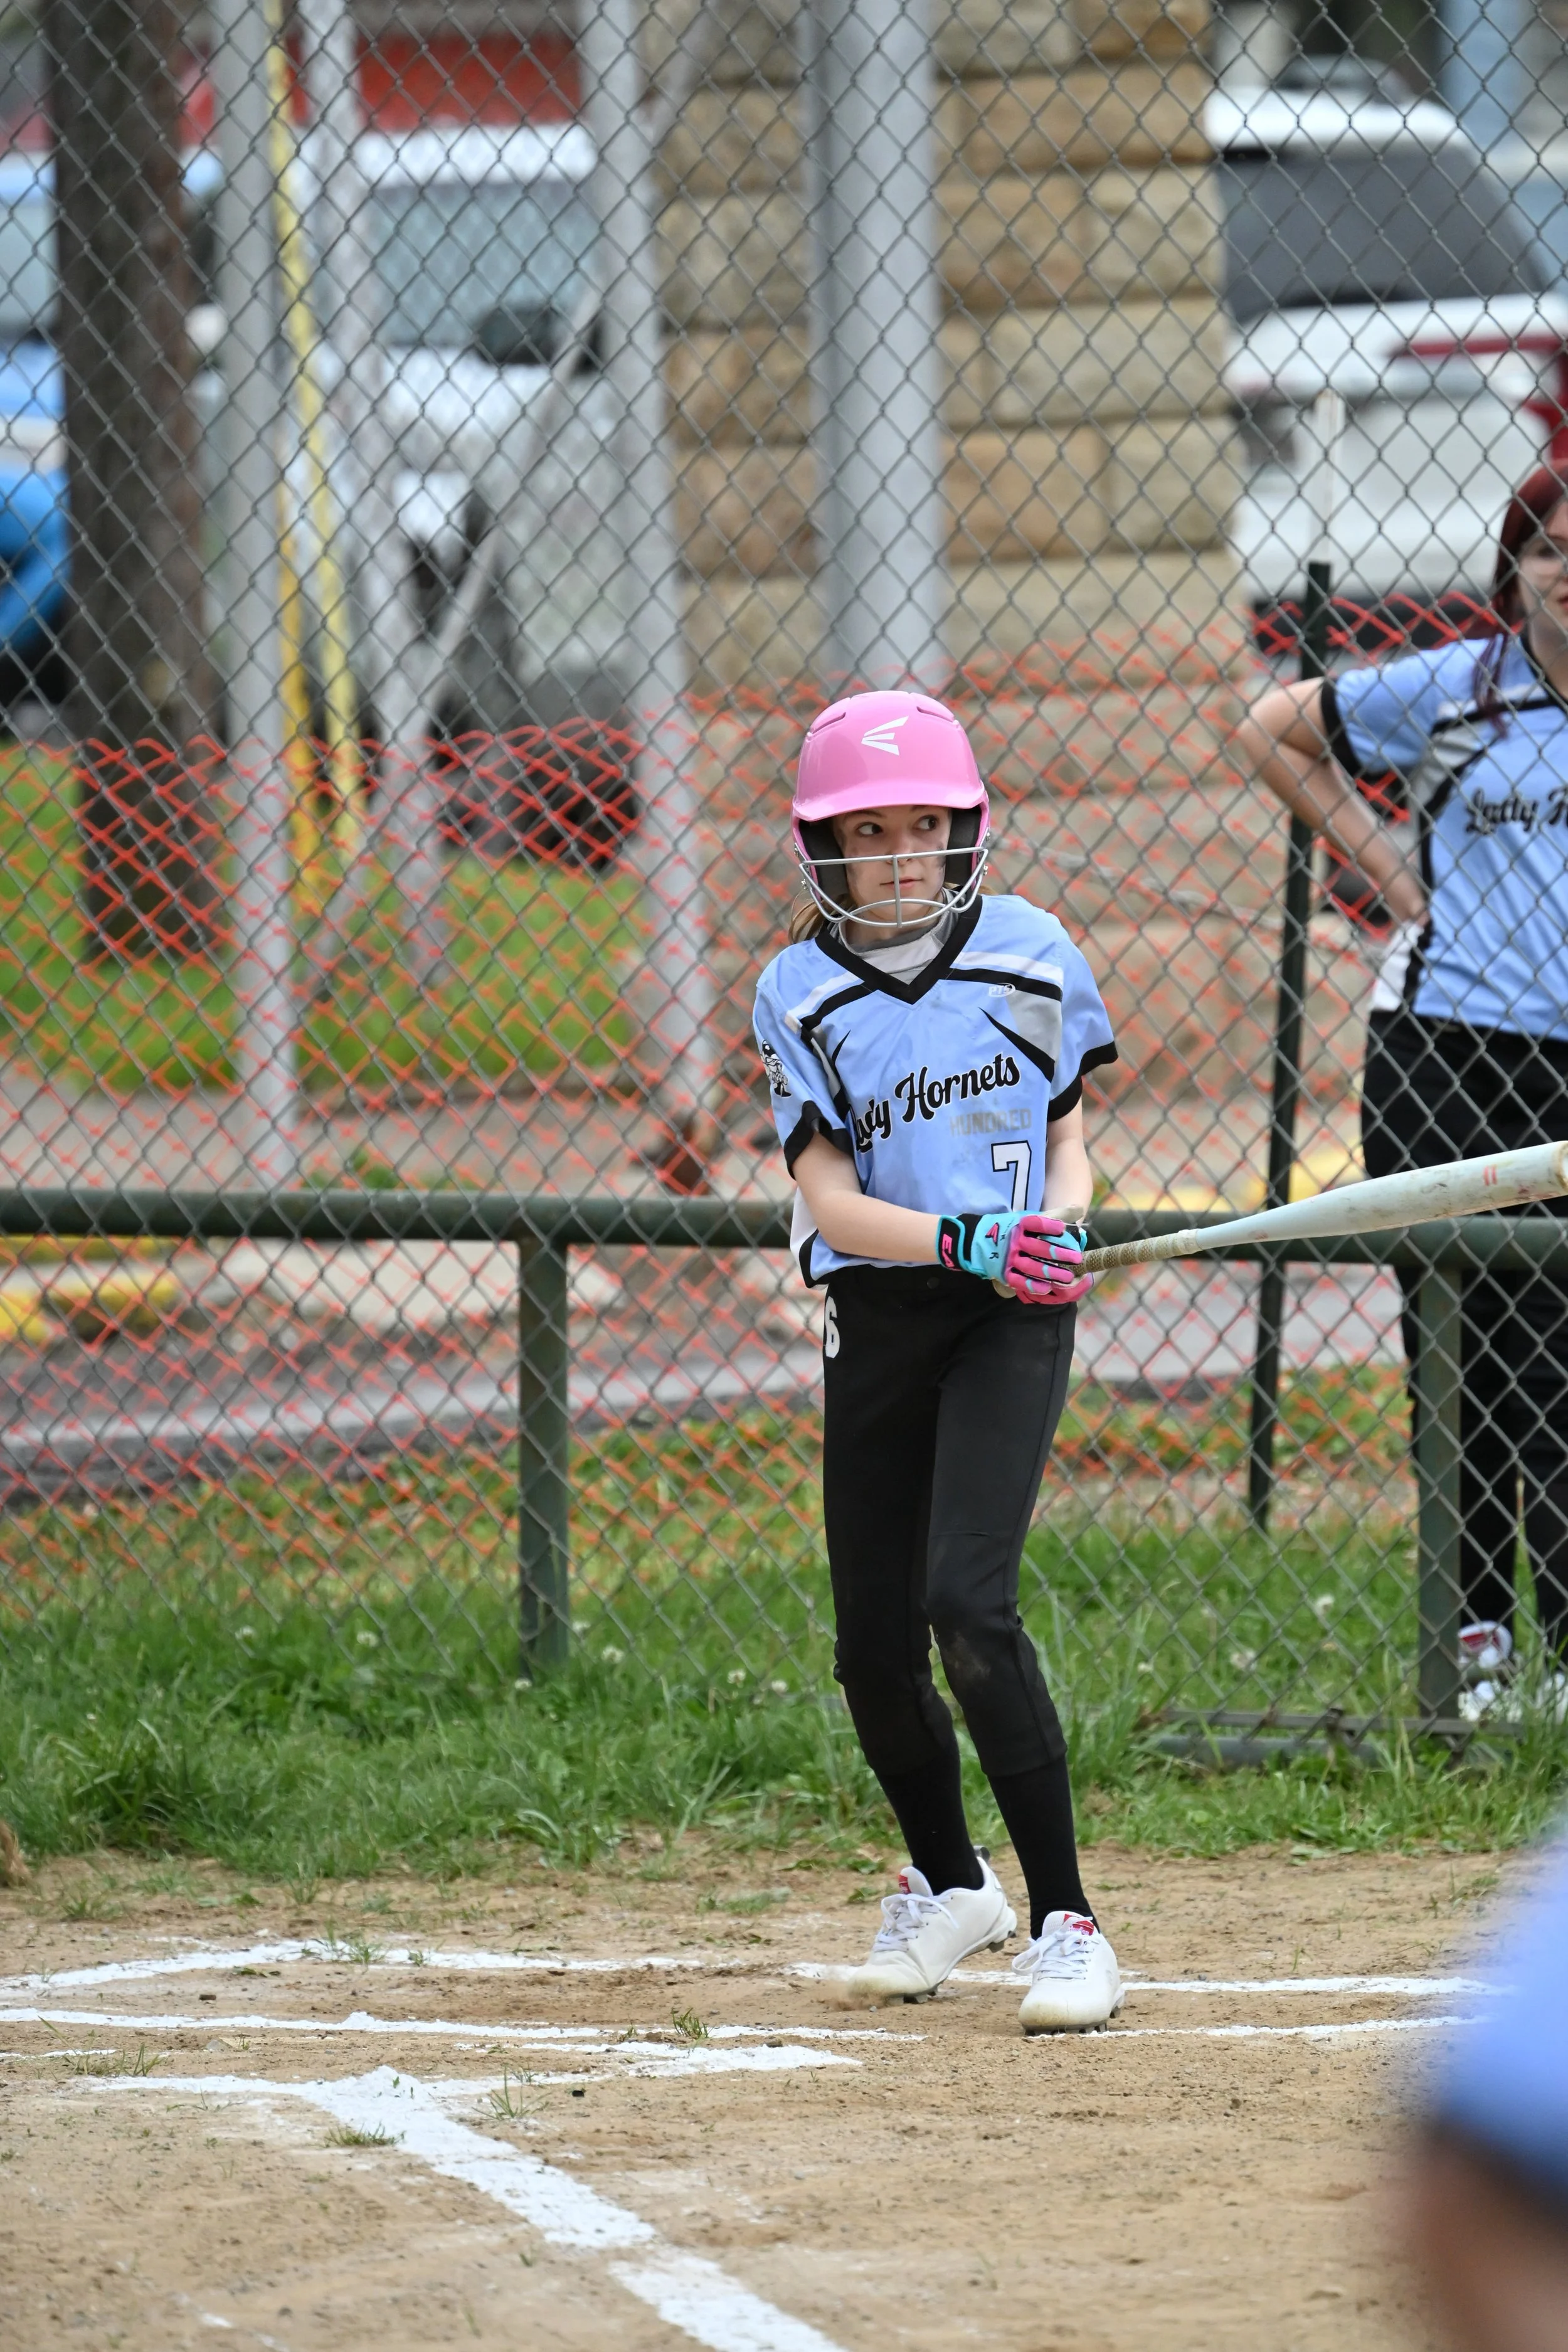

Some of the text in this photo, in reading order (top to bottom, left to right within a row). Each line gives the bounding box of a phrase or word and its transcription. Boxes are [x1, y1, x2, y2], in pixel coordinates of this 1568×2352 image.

[988, 985, 1012, 996] PTS
[894, 1053, 1020, 1123] Hornets
[950, 1108, 1032, 1136] HUNDRED
[991, 1140, 1032, 1211] 7
[825, 1295, 840, 1359] 6
